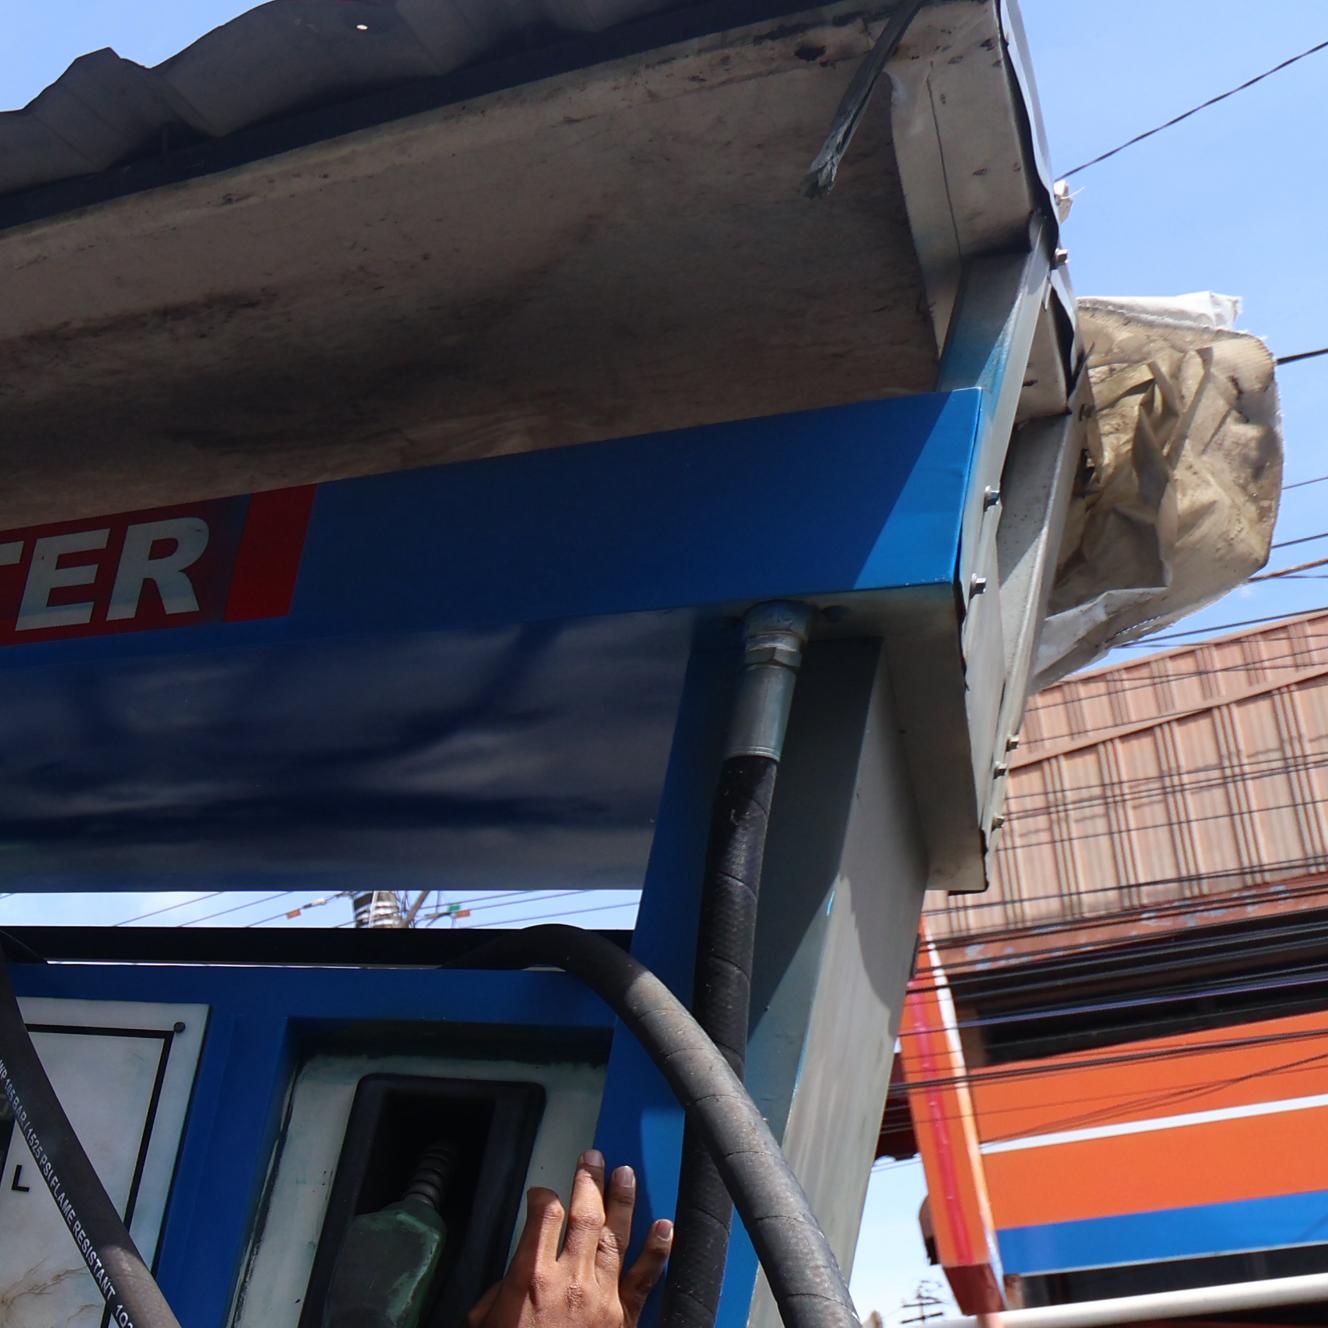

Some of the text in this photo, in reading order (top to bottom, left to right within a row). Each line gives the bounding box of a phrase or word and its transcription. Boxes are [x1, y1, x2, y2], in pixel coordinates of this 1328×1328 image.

[11, 1164, 30, 1193] L
[38, 1153, 54, 1181] PSI
[50, 1177, 76, 1226] FLAME
[72, 1219, 116, 1302] RESISTANT
